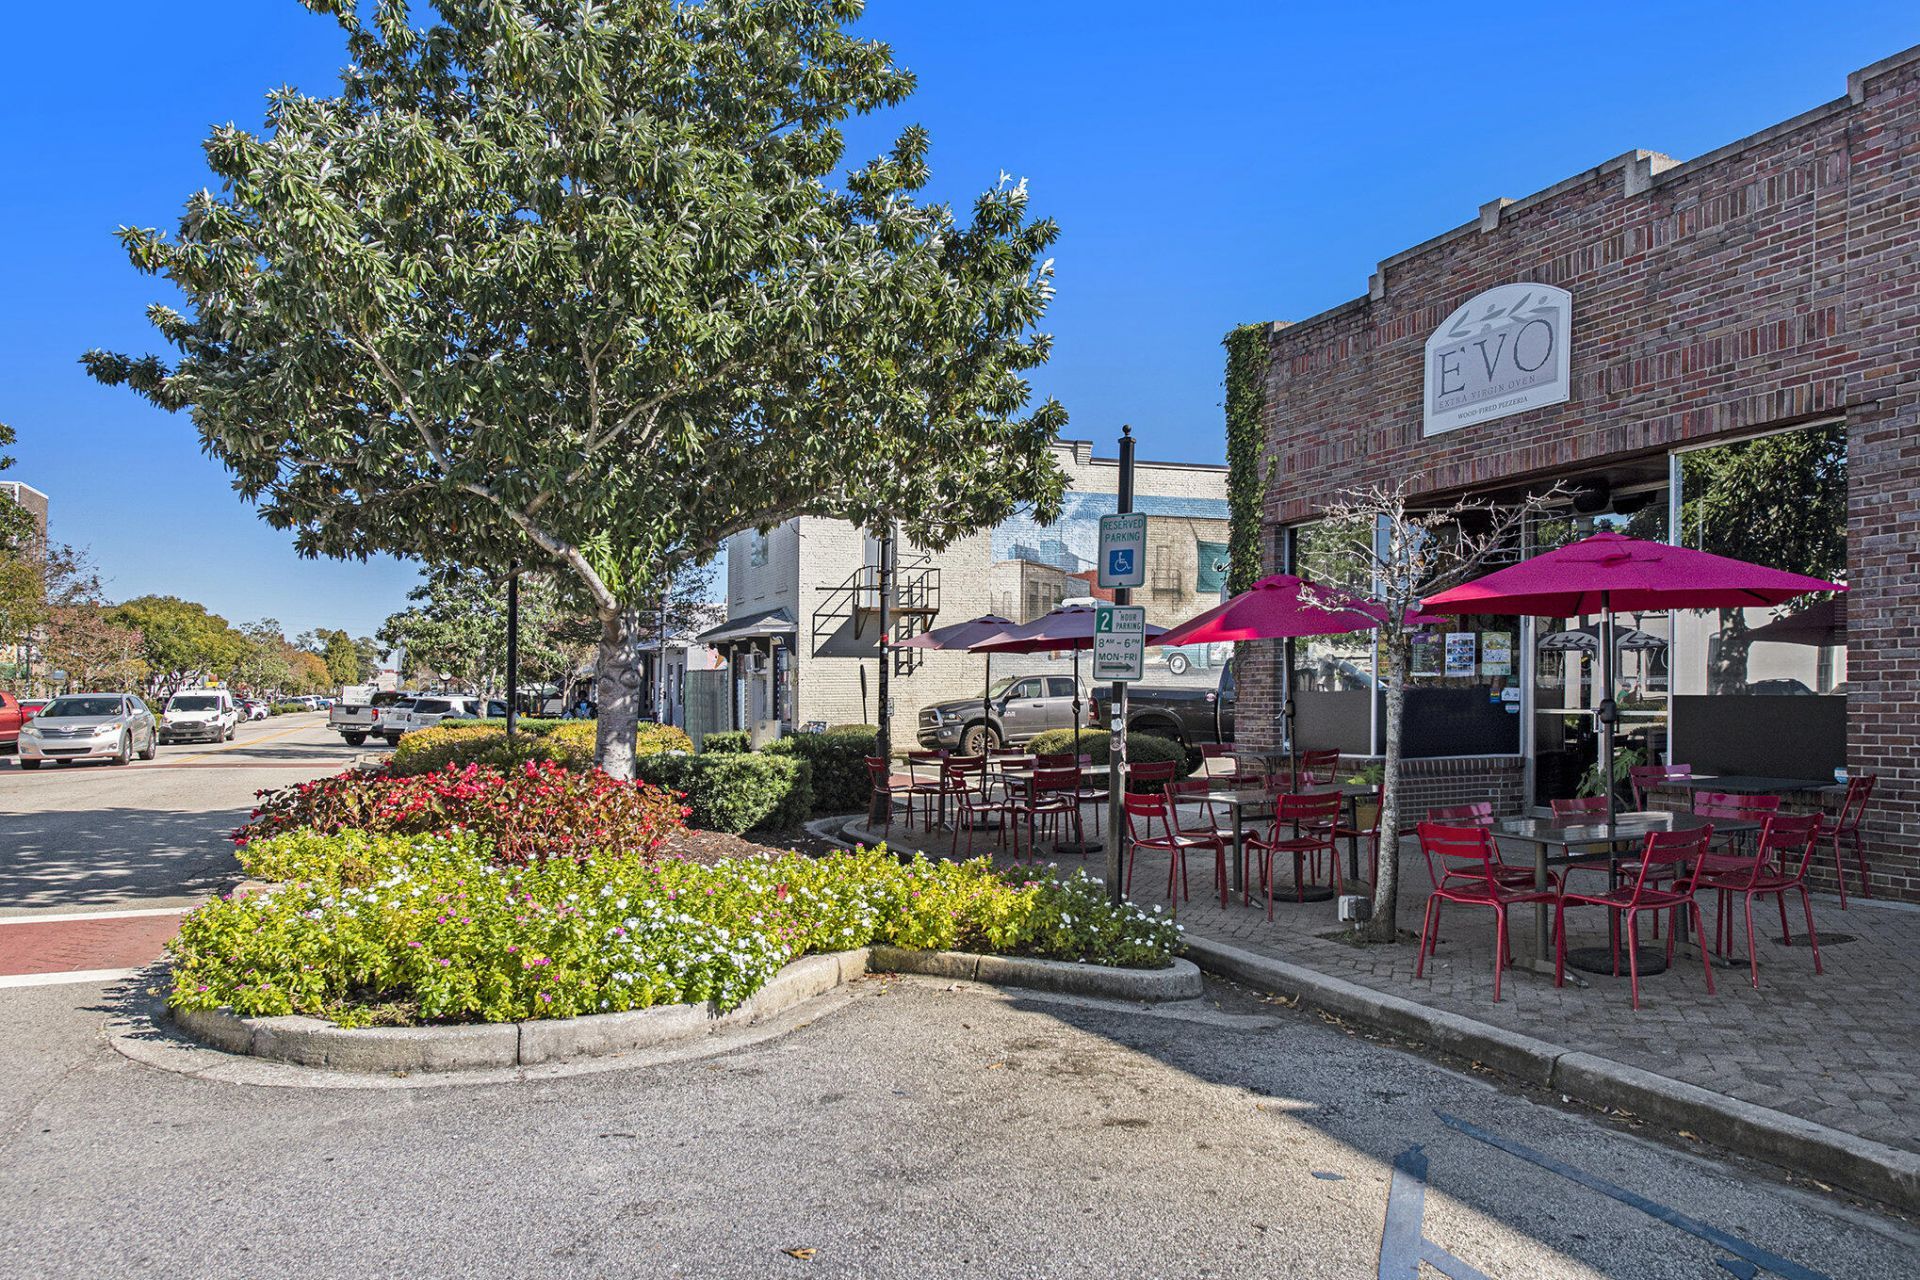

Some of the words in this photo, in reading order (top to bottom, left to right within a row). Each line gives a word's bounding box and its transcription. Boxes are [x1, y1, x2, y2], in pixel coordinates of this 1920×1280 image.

[1438, 319, 1553, 398] EVO
[1439, 395, 1467, 408] EXTRA
[1471, 384, 1505, 400] VIRGIN
[1508, 374, 1536, 390] OVEN
[1498, 396, 1528, 409] PIZZERIA
[1103, 518, 1144, 531] RESERVED
[1105, 531, 1140, 543] PARKING
[1101, 611, 1110, 631] 2
[1120, 613, 1137, 622] HOUR
[1115, 622, 1141, 630] PARKING
[1098, 652, 1138, 661] MON-FRI
